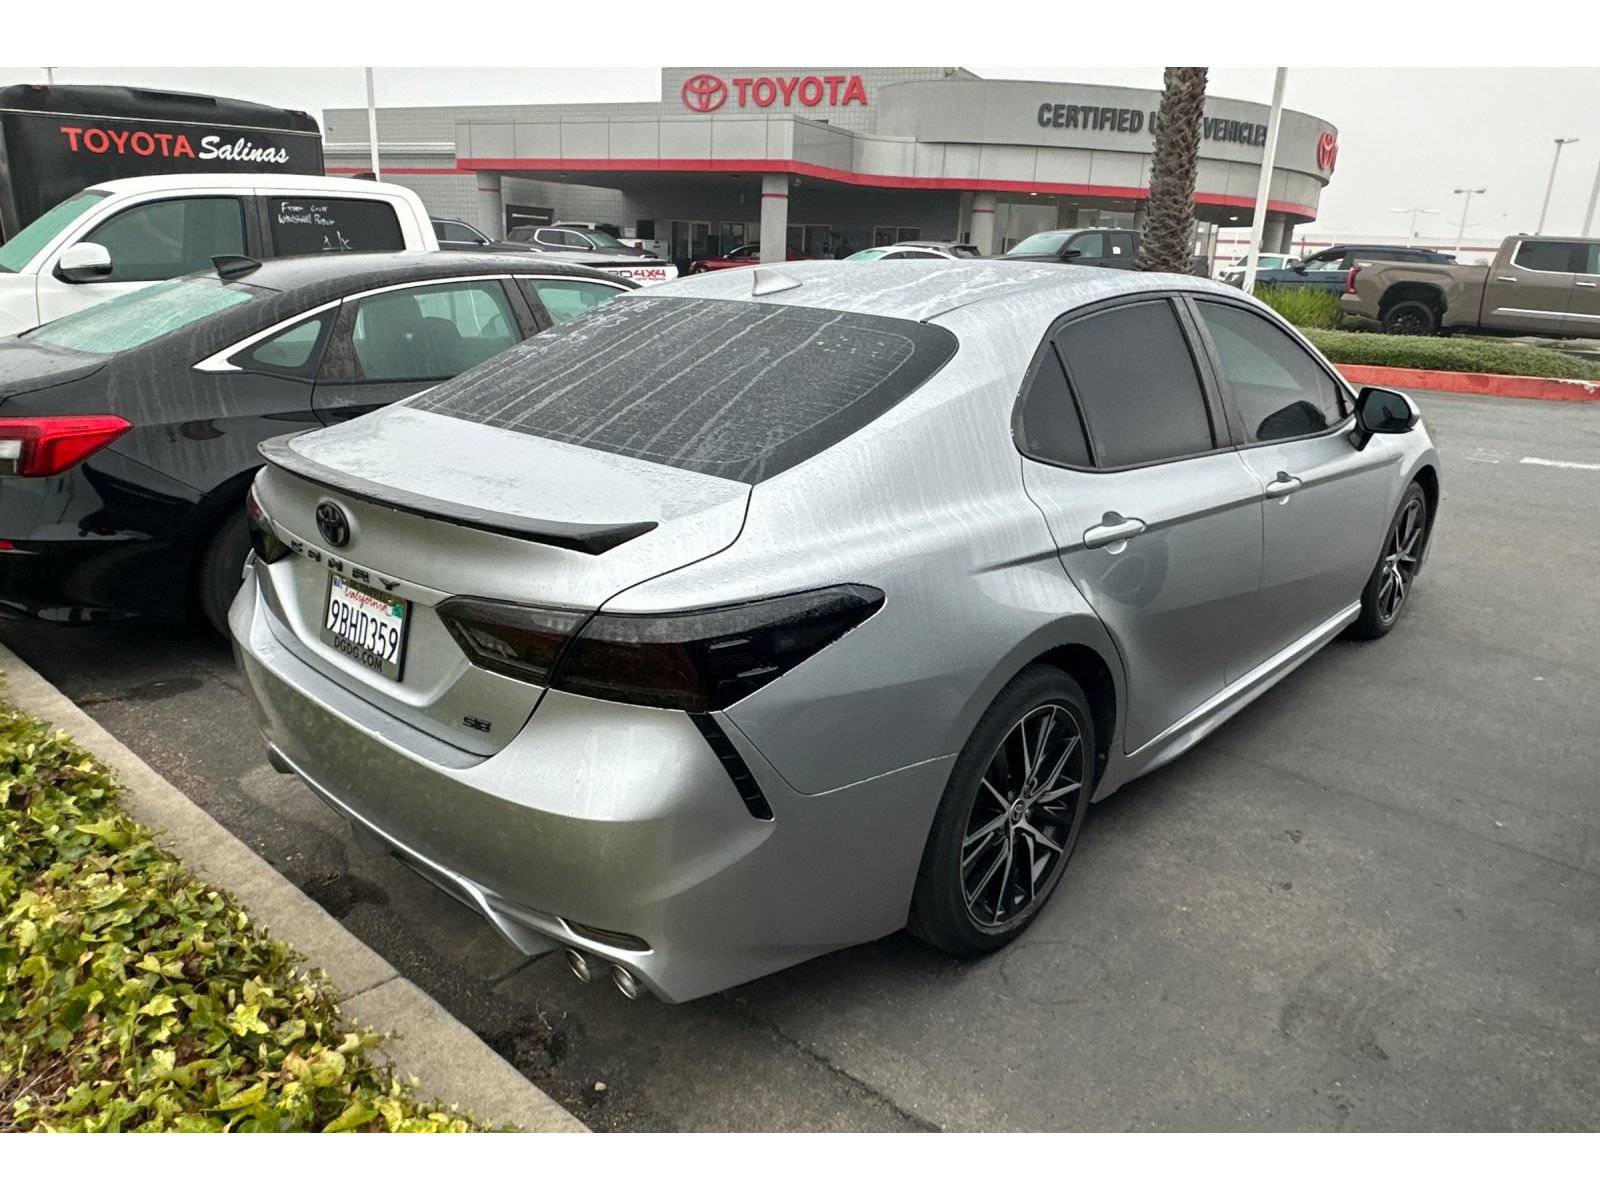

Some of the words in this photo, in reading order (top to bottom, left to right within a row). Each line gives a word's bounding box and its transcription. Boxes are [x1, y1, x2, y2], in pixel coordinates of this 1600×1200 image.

[732, 75, 868, 107] TOYOTA
[1038, 103, 1144, 132] CERTIFIED
[60, 127, 197, 158] TOYOTA
[199, 136, 289, 164] Salinas
[633, 269, 666, 277] 4X4
[291, 540, 400, 591] CAMRY
[344, 586, 392, 617] California
[325, 599, 399, 662] 9BHD359
[334, 635, 383, 673] DGDG.COM
